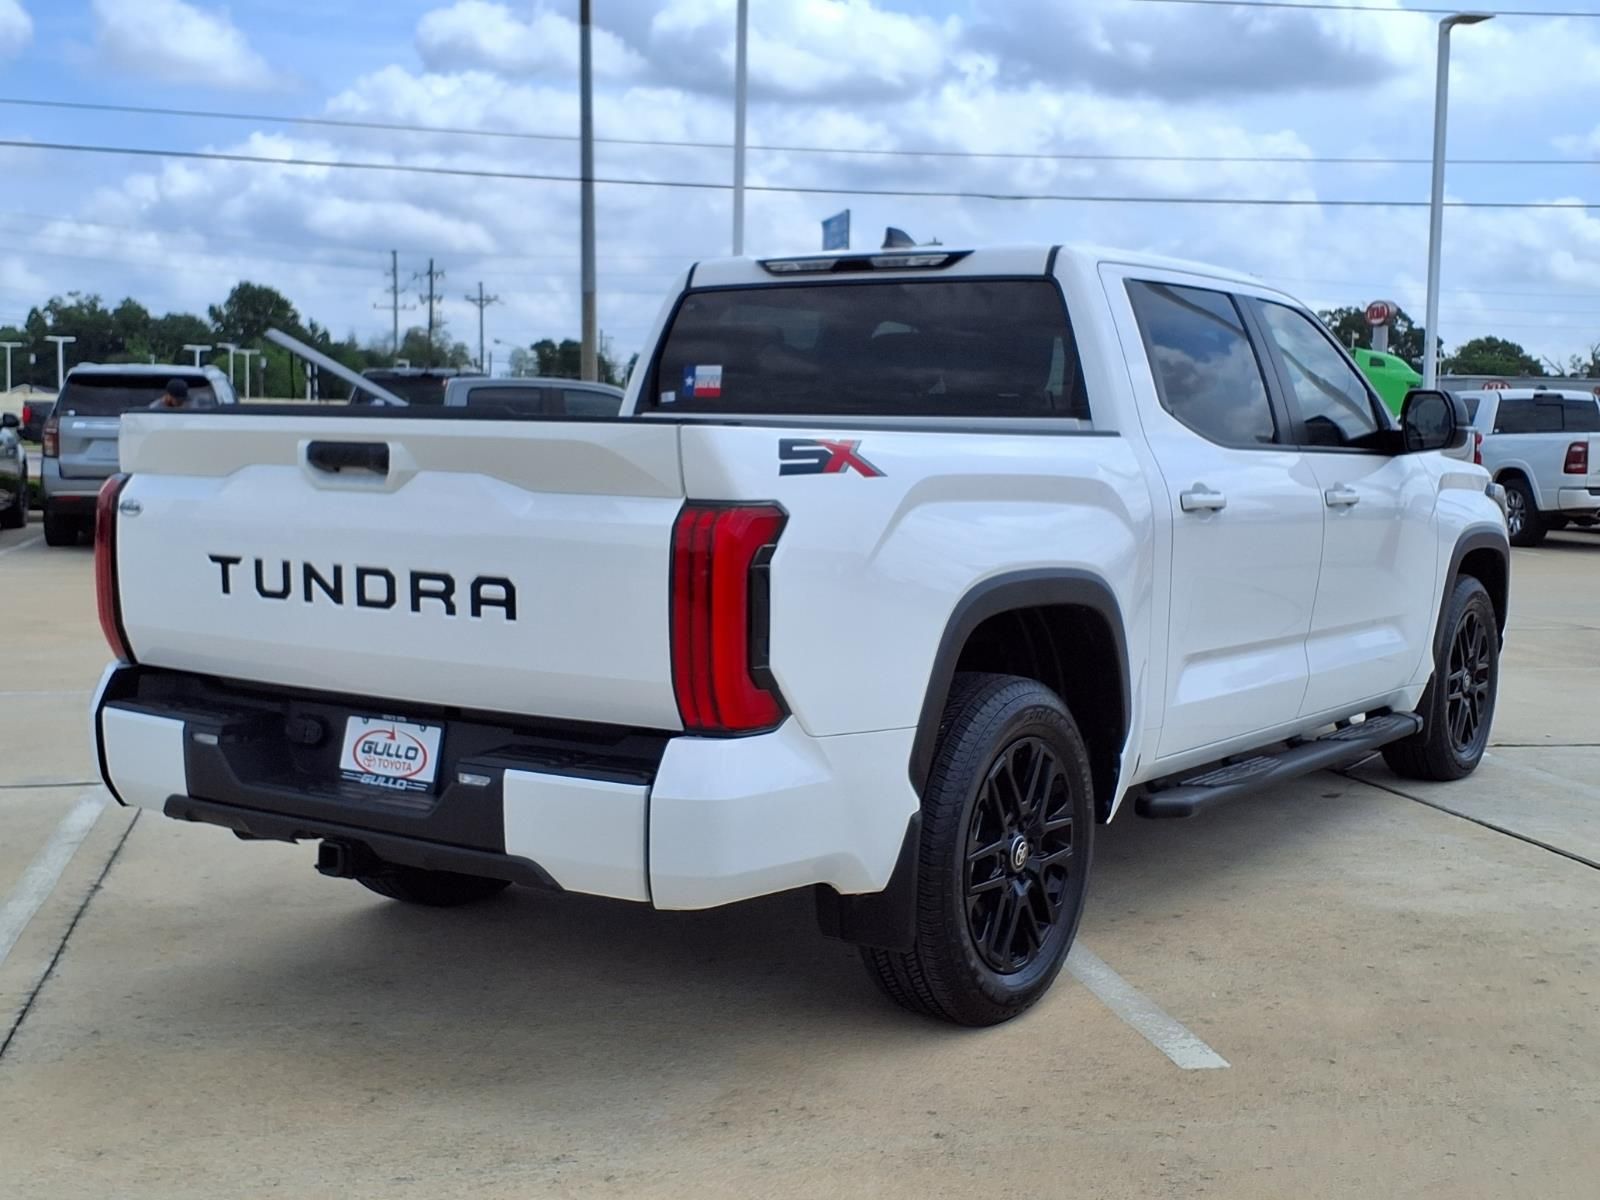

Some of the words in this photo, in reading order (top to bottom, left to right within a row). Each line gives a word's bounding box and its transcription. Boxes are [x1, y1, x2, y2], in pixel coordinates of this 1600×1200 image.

[208, 554, 517, 621] TUNDRA
[362, 740, 419, 760] GULLO
[377, 758, 413, 772] TOYOTA
[361, 774, 408, 790] GULLO
